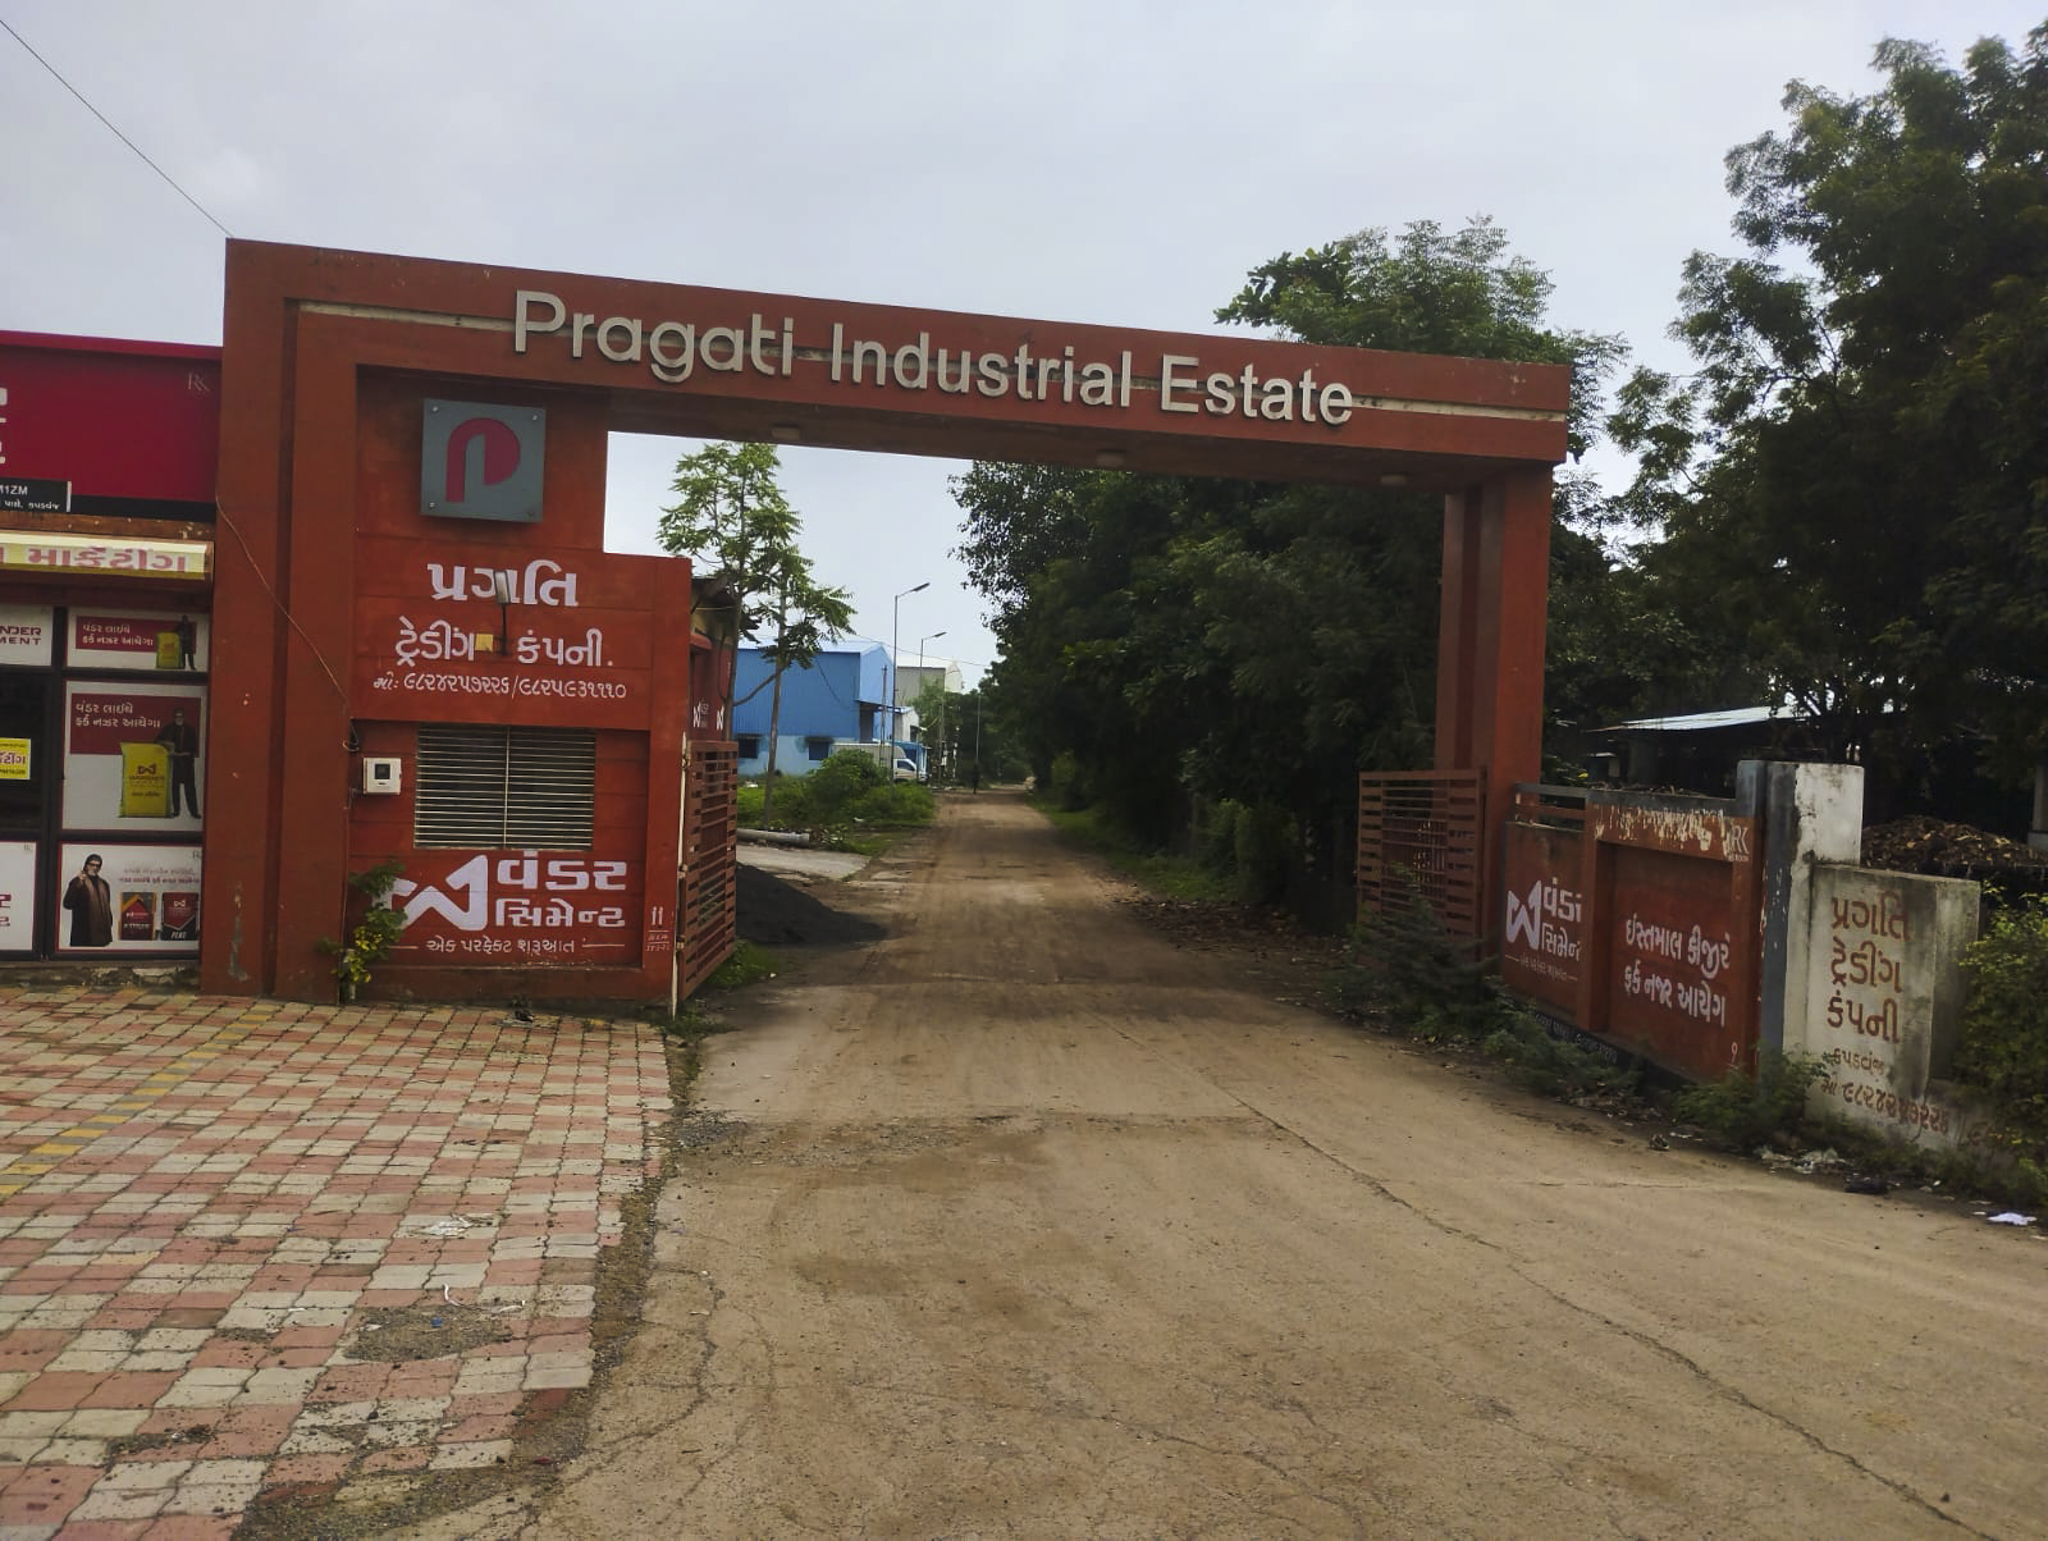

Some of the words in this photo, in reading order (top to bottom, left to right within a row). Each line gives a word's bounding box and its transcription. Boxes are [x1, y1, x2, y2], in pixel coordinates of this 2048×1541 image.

[513, 289, 794, 384] Pragati
[831, 323, 1132, 408] Industrial
[1161, 354, 1353, 426] Estate
[427, 559, 579, 607] પ્રગતિ
[395, 615, 476, 668] ટ્રેડીંગ
[496, 850, 627, 890] વંડર
[495, 898, 626, 927] સિમેન્ટ
[426, 934, 457, 953] એક
